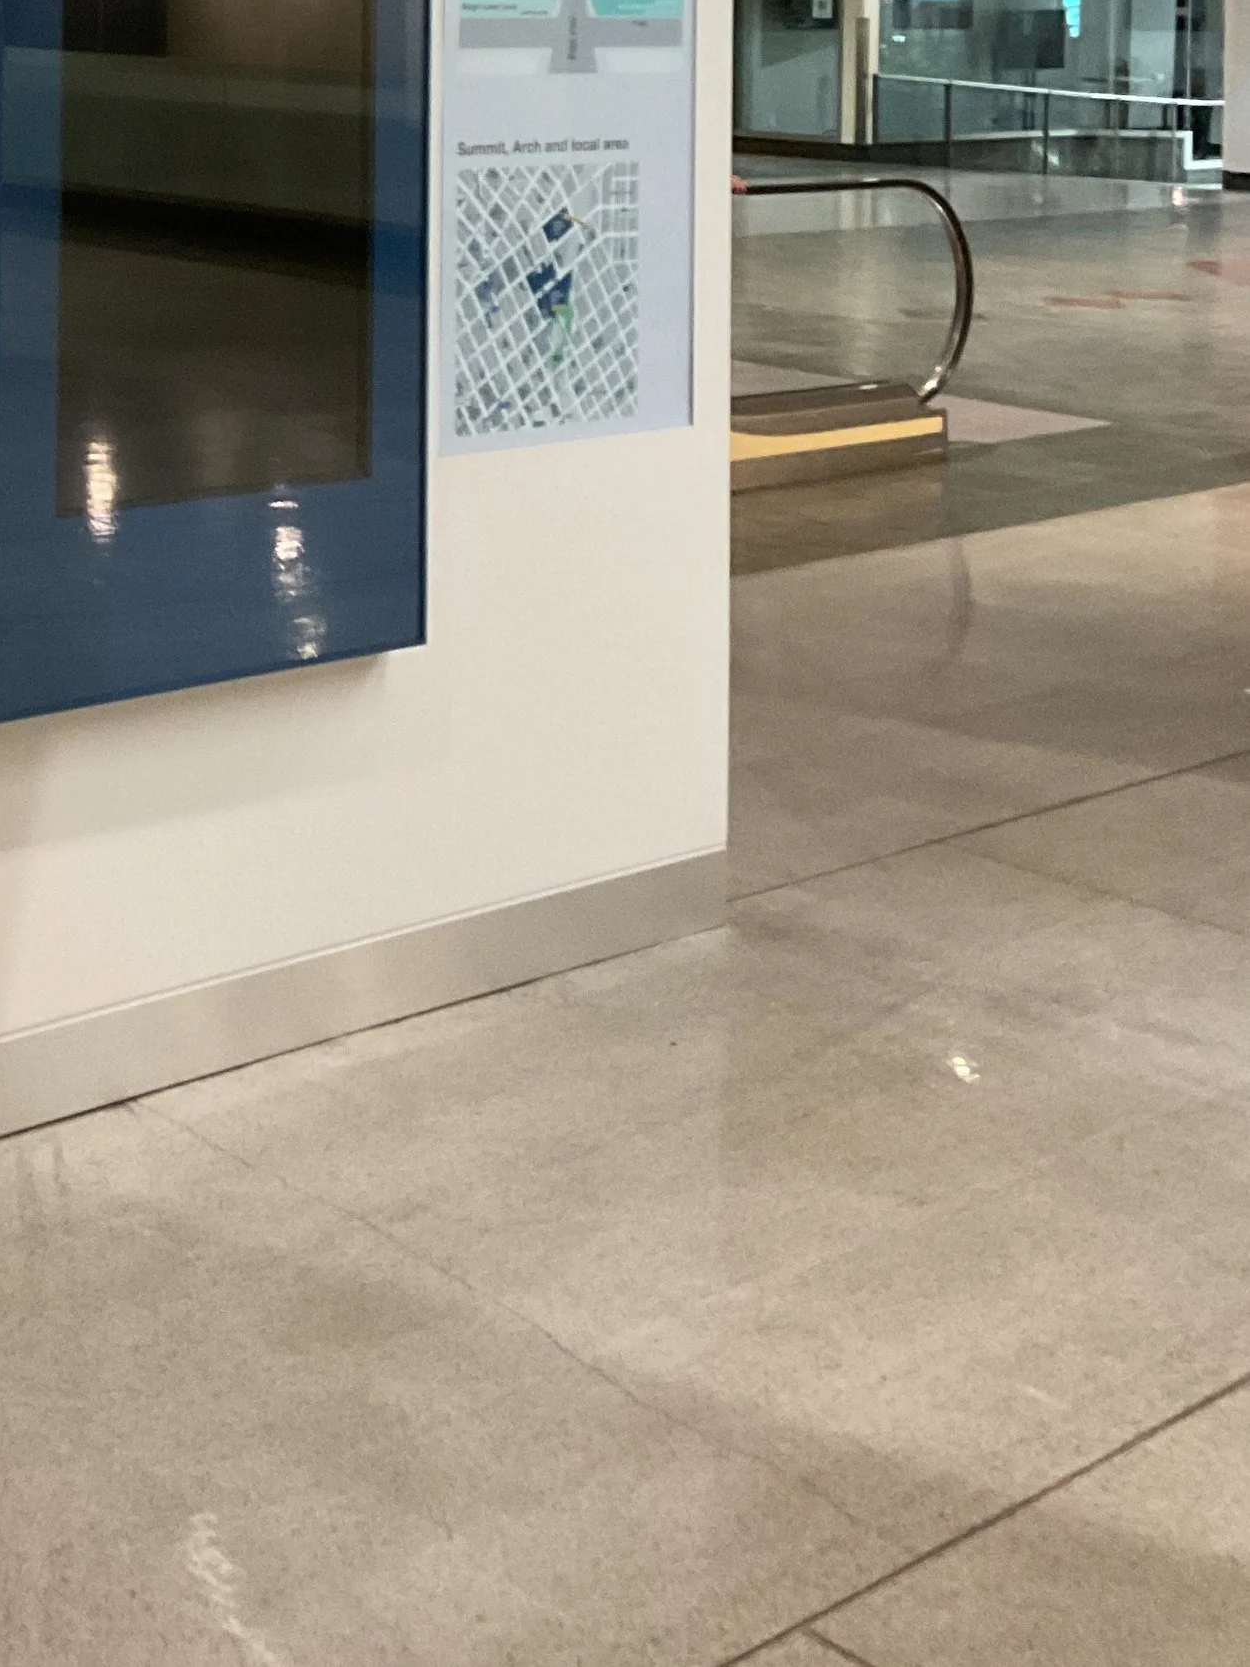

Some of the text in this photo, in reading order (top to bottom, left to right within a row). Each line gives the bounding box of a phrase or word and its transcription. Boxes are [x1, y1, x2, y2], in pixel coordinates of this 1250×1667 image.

[456, 137, 630, 156] Summit, Arch and local area
